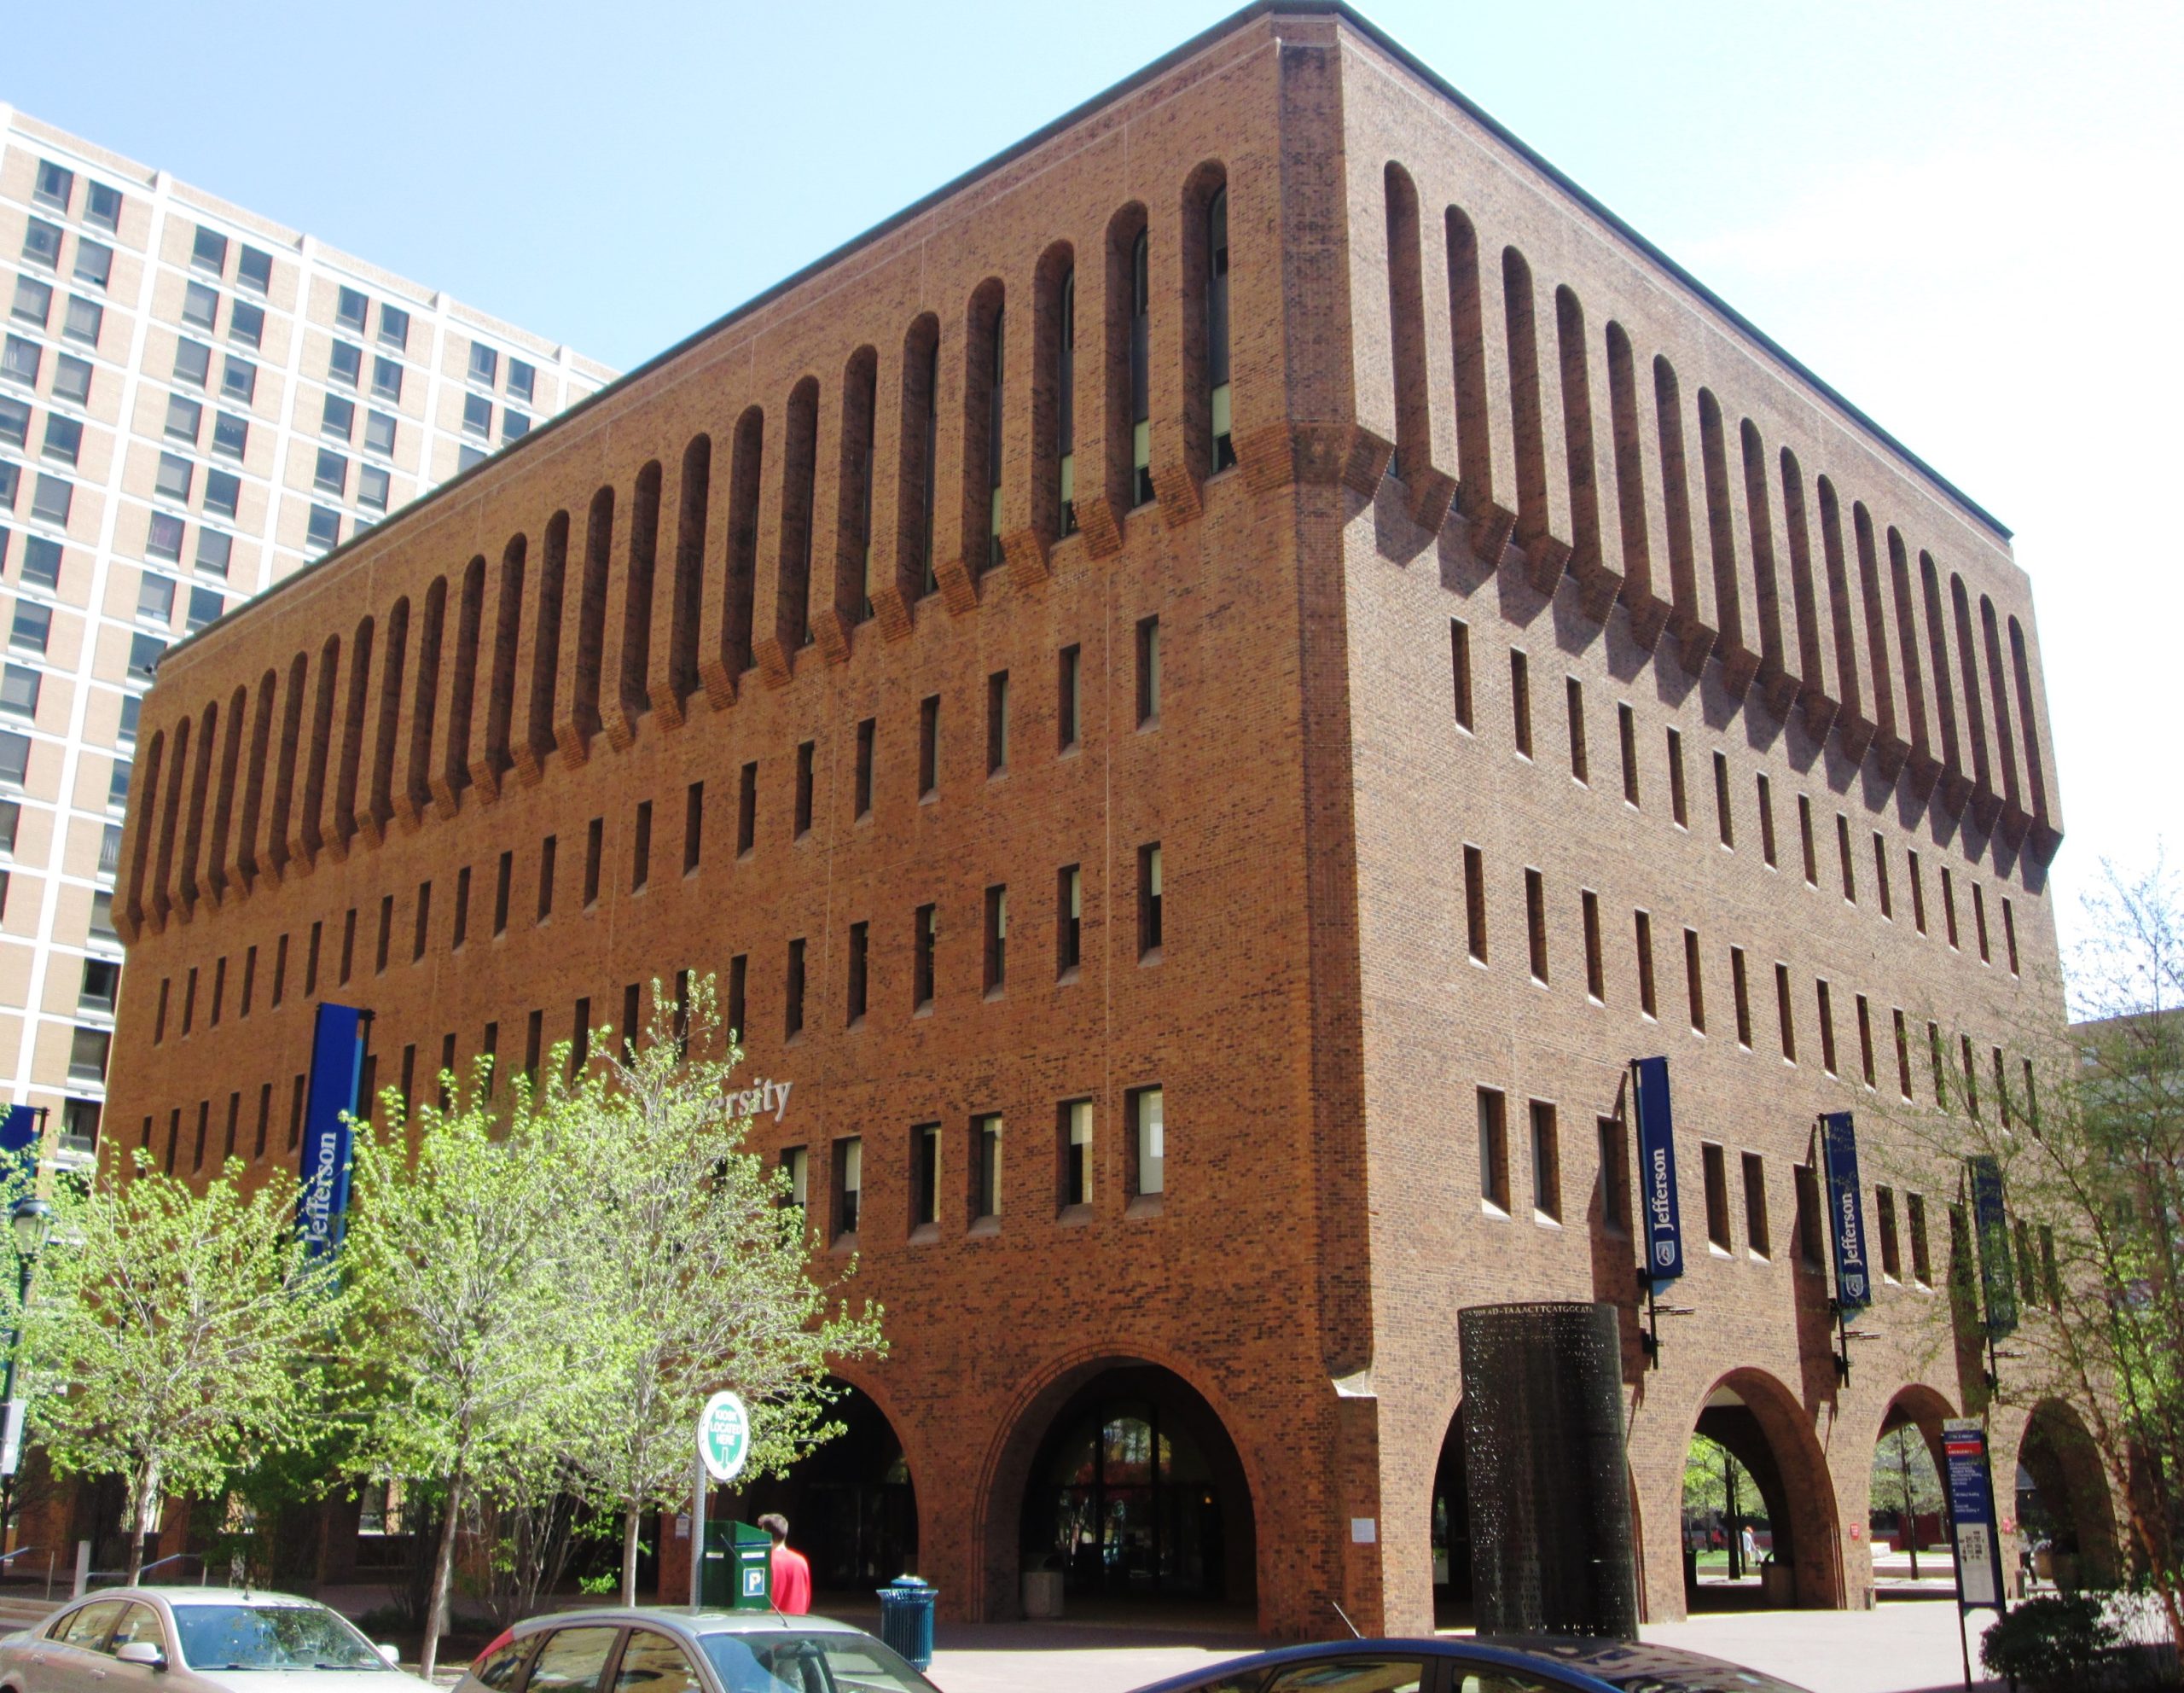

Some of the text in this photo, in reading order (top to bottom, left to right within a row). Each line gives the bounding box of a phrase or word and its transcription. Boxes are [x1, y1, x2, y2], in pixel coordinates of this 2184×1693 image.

[305, 1132, 336, 1247] Jefferson
[1652, 1148, 1674, 1230] Jefferson
[1841, 1192, 1862, 1266] Jefferson
[715, 1410, 738, 1422] KIOSK
[710, 1421, 742, 1435] LOCATED
[716, 1434, 735, 1446] HERE
[749, 1573, 761, 1591] P
